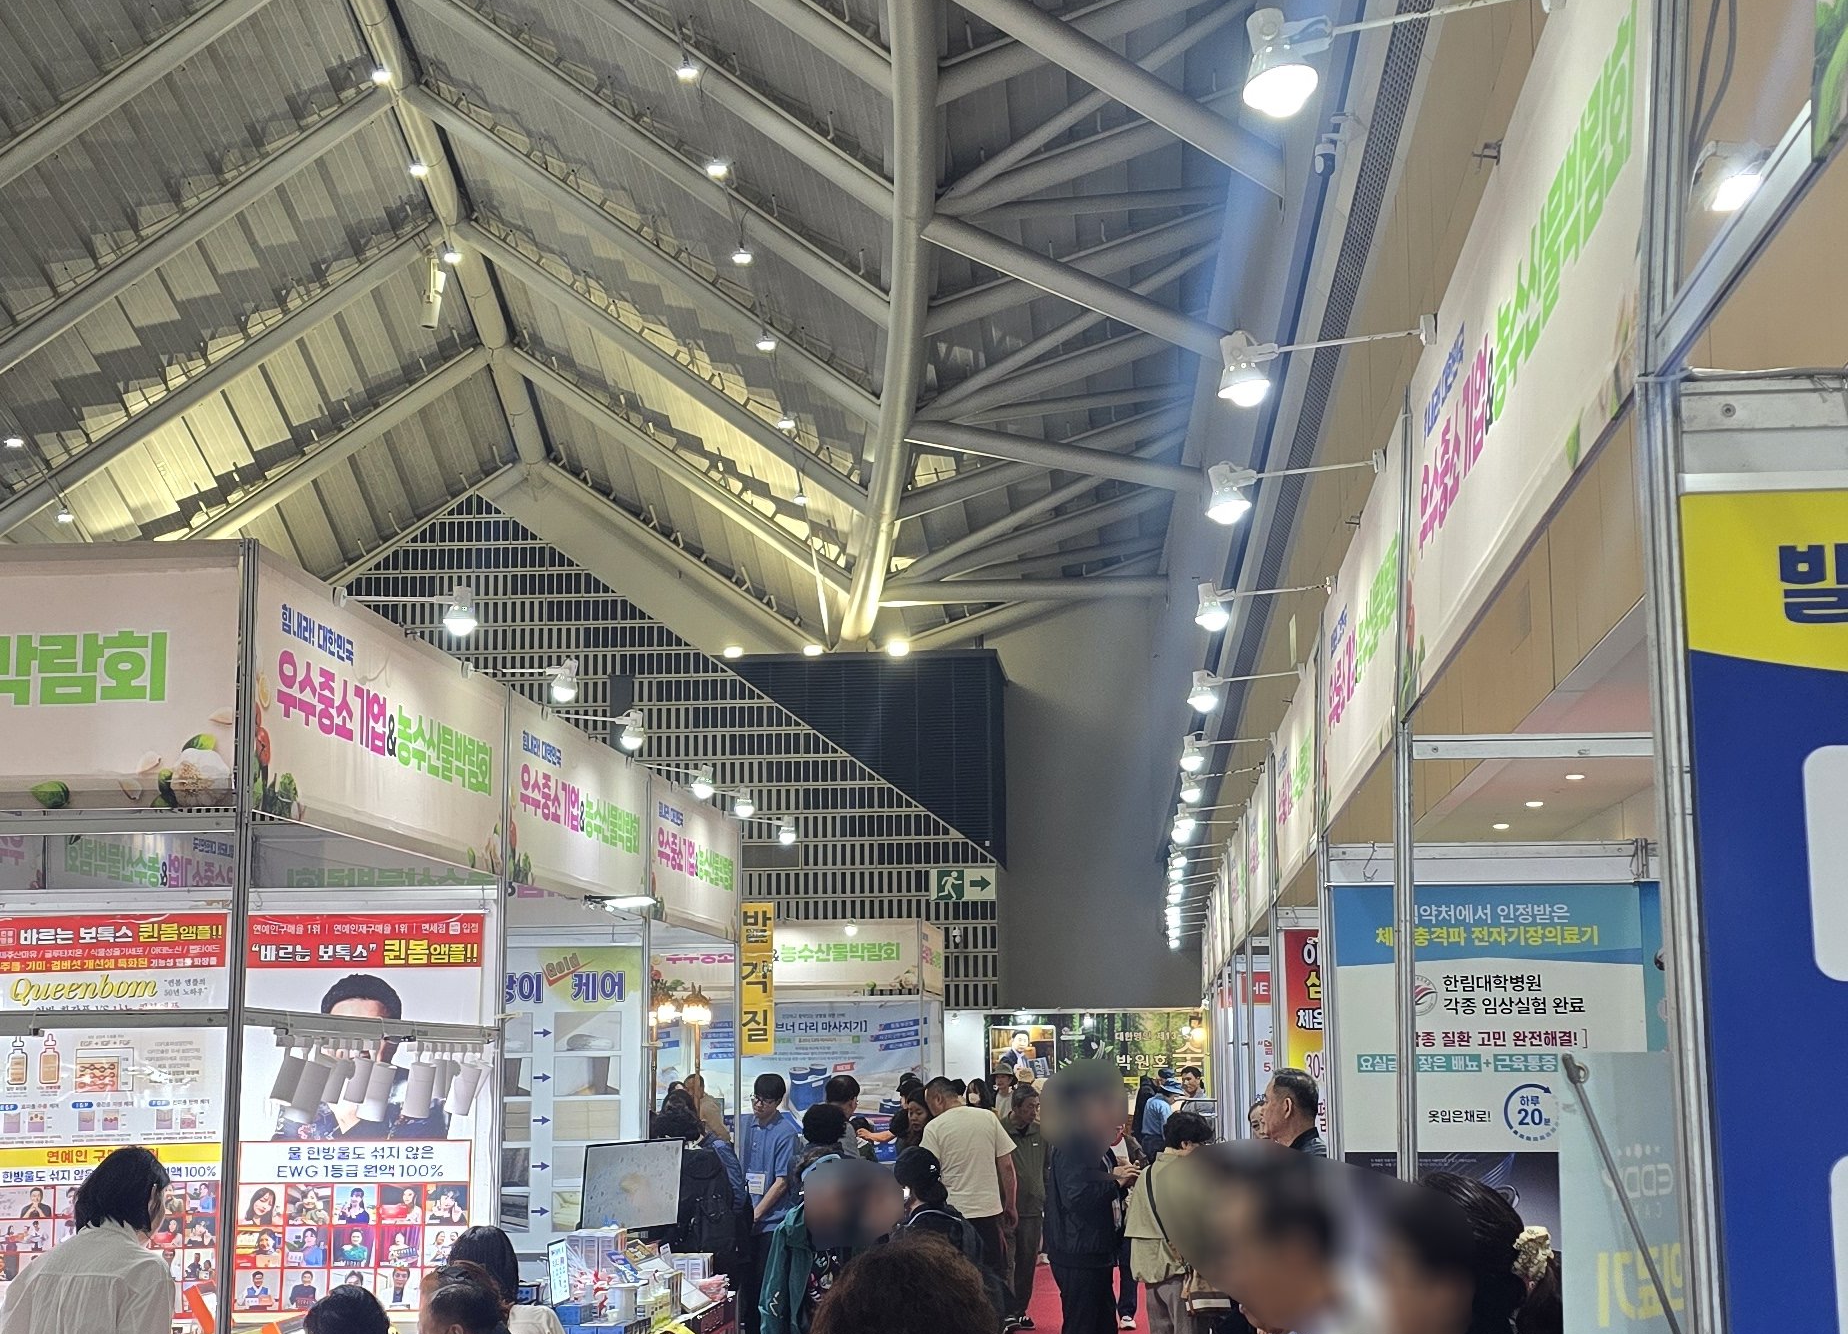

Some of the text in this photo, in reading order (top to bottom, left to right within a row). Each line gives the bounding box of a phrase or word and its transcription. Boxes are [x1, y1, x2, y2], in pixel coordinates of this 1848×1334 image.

[281, 603, 354, 666] 힘내라! 대한민국
[1497, 904, 1570, 924] 인정받은
[19, 928, 74, 945] 바르는
[78, 926, 133, 943] 보톡스
[138, 923, 223, 942] 퀸봄앰플!!
[252, 923, 304, 935] 연예인구매율
[307, 923, 321, 935] 1위
[394, 923, 408, 935] 1위
[421, 923, 446, 934] 면세점
[462, 922, 479, 934] 입점
[1376, 925, 1599, 947] 체충격파 전자기장의료기
[383, 938, 478, 965] 퀸봄앰플!!
[545, 952, 581, 978] Gold
[10, 973, 158, 1006] Queenbom
[572, 970, 625, 1003] 케어
[1442, 974, 1542, 993] 한림대학병원
[1443, 997, 1586, 1016] 각종 임상실험 완료
[798, 1021, 819, 1033] 다리
[1442, 1031, 1473, 1047] 질환
[1478, 1031, 1507, 1047] 고민
[1512, 1030, 1578, 1047] 완전해결!
[1116, 1054, 1169, 1071] 박원호
[1418, 1056, 1447, 1071] 잦은
[1452, 1056, 1479, 1071] 배뇨
[1495, 1056, 1557, 1071] 근육통증
[1519, 1095, 1541, 1107] 하루
[1428, 1109, 1492, 1124] 옷입은채로!
[46, 1149, 88, 1164] 연예인
[288, 1145, 434, 1161] 물 한방울도 섞지 않은
[2, 1170, 46, 1183] 한방울도
[49, 1169, 71, 1181] 섞지
[185, 1166, 217, 1178] 100%
[276, 1164, 444, 1178] EWG 1등급 원액 100%
